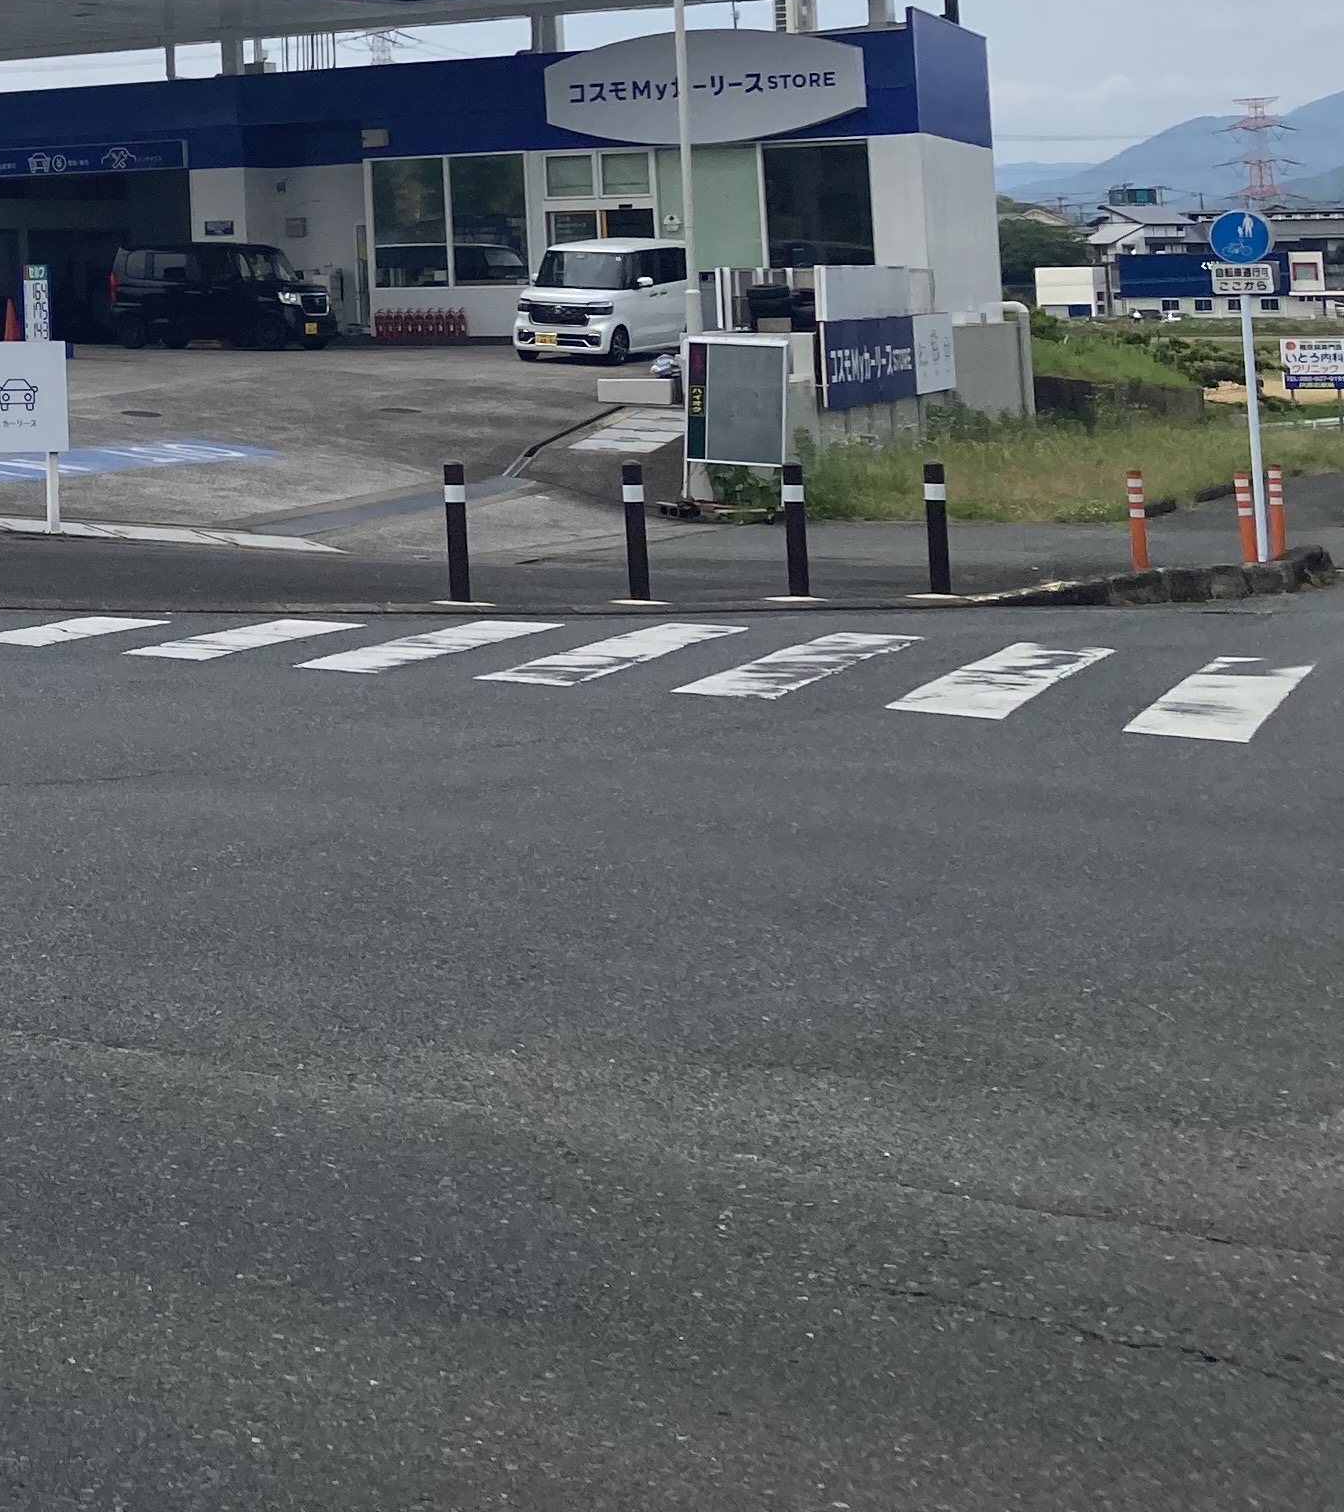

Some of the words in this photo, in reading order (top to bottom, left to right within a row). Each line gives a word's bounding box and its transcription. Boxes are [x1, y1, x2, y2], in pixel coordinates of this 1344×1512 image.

[1219, 281, 1267, 292] ここから
[1285, 353, 1344, 363] いとう内科
[1292, 364, 1339, 374] クリニック
[692, 388, 703, 413] ハイオク
[2, 419, 37, 428] カーリース
